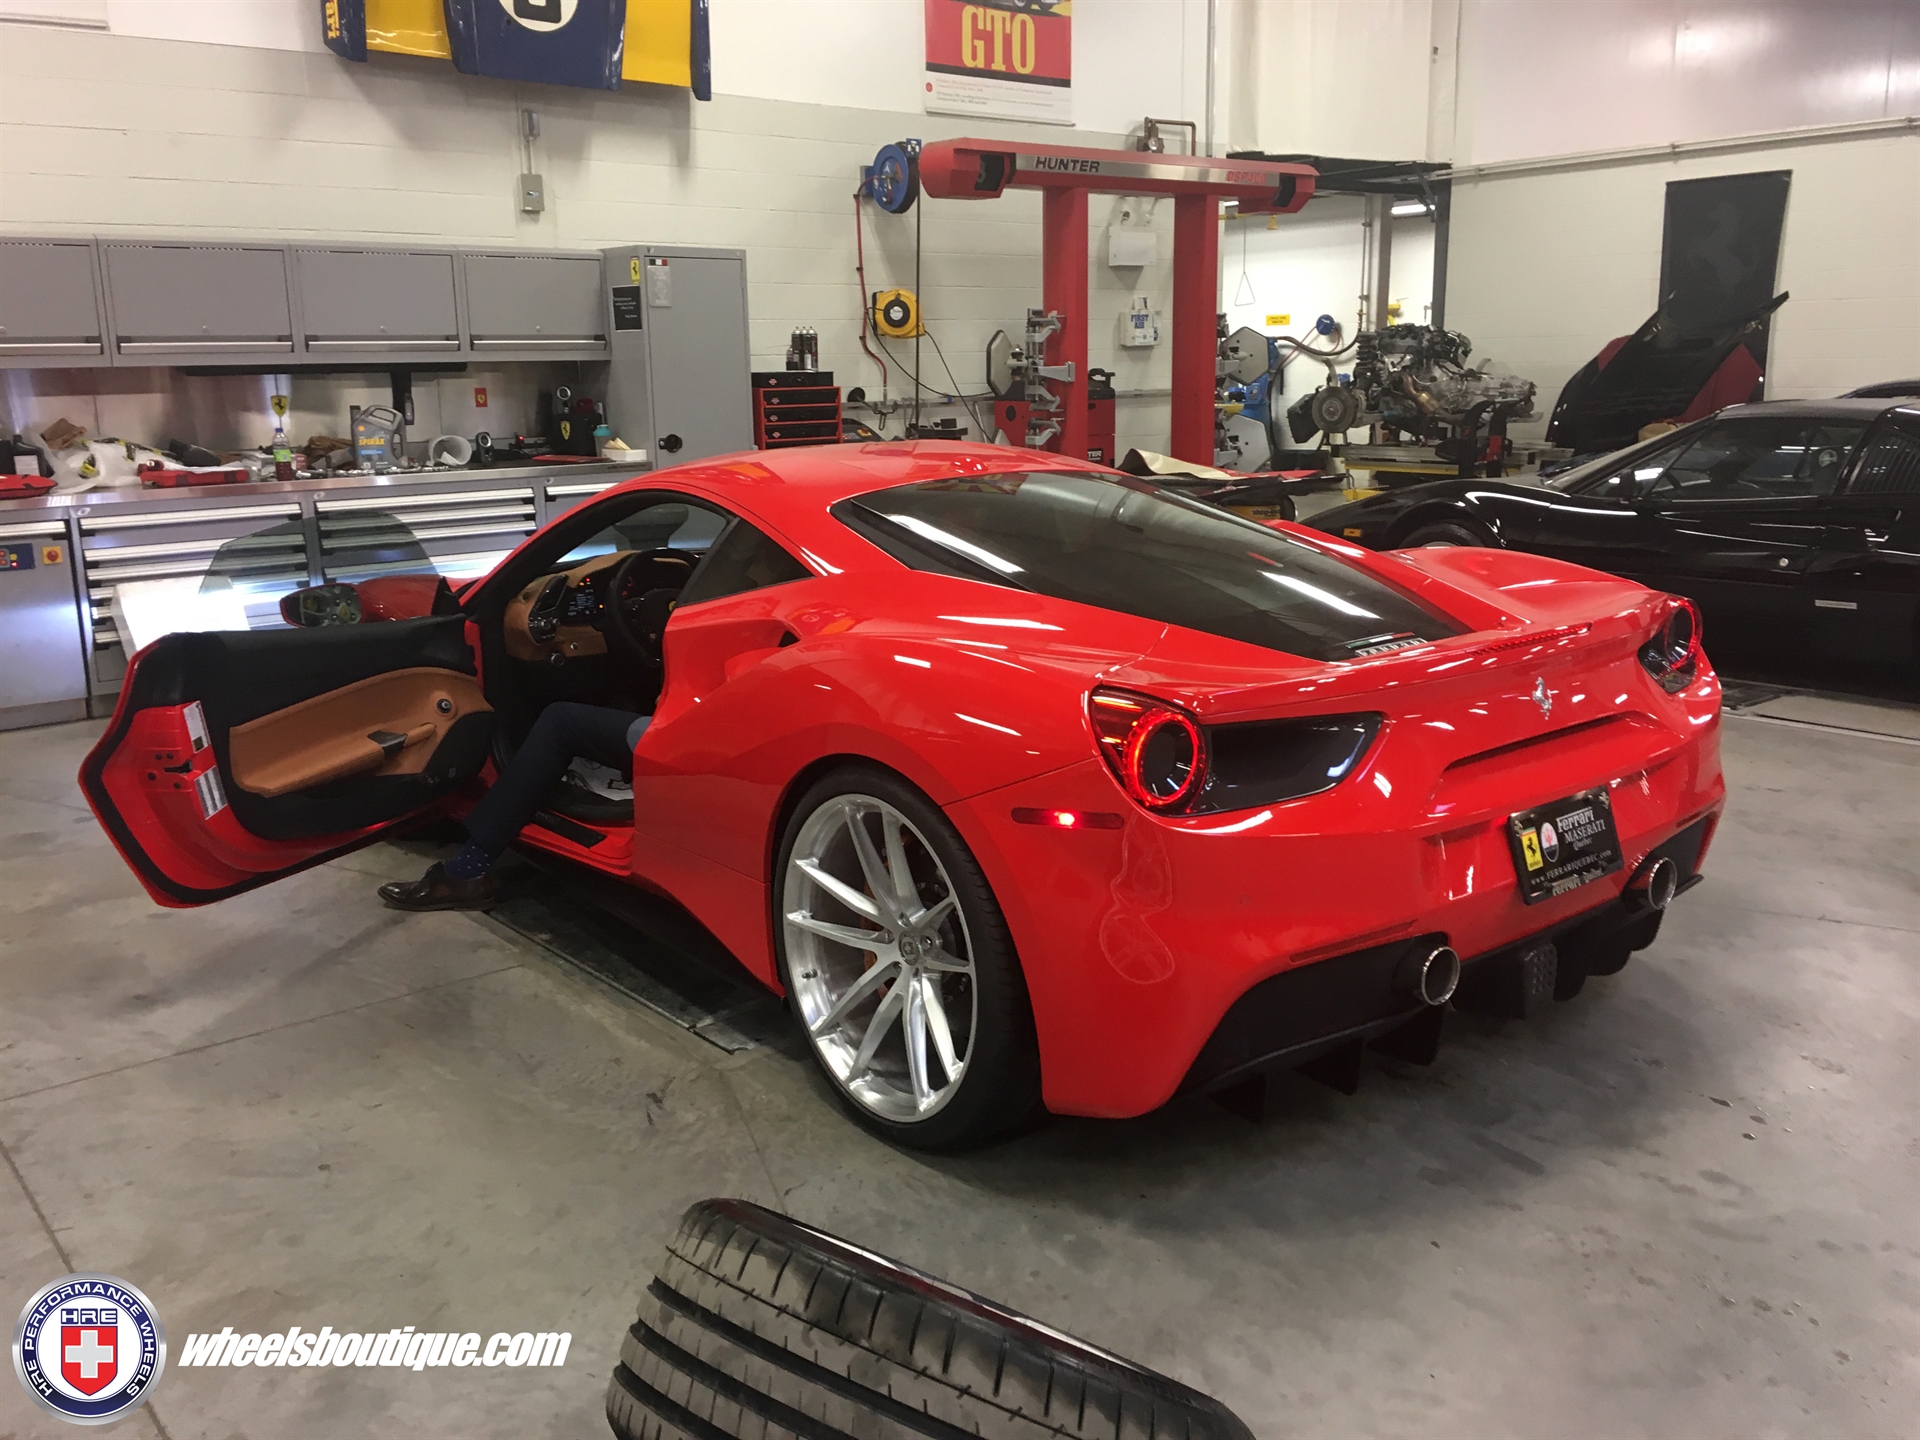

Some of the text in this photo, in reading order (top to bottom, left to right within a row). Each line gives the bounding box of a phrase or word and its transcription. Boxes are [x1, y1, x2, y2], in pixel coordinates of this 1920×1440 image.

[962, 5, 1035, 74] GTO
[1035, 156, 1100, 173] HUNTER
[1131, 314, 1149, 322] FIRST
[1134, 321, 1145, 329] AID
[1556, 806, 1595, 833] Ferrari
[1564, 819, 1606, 844] MASERATI
